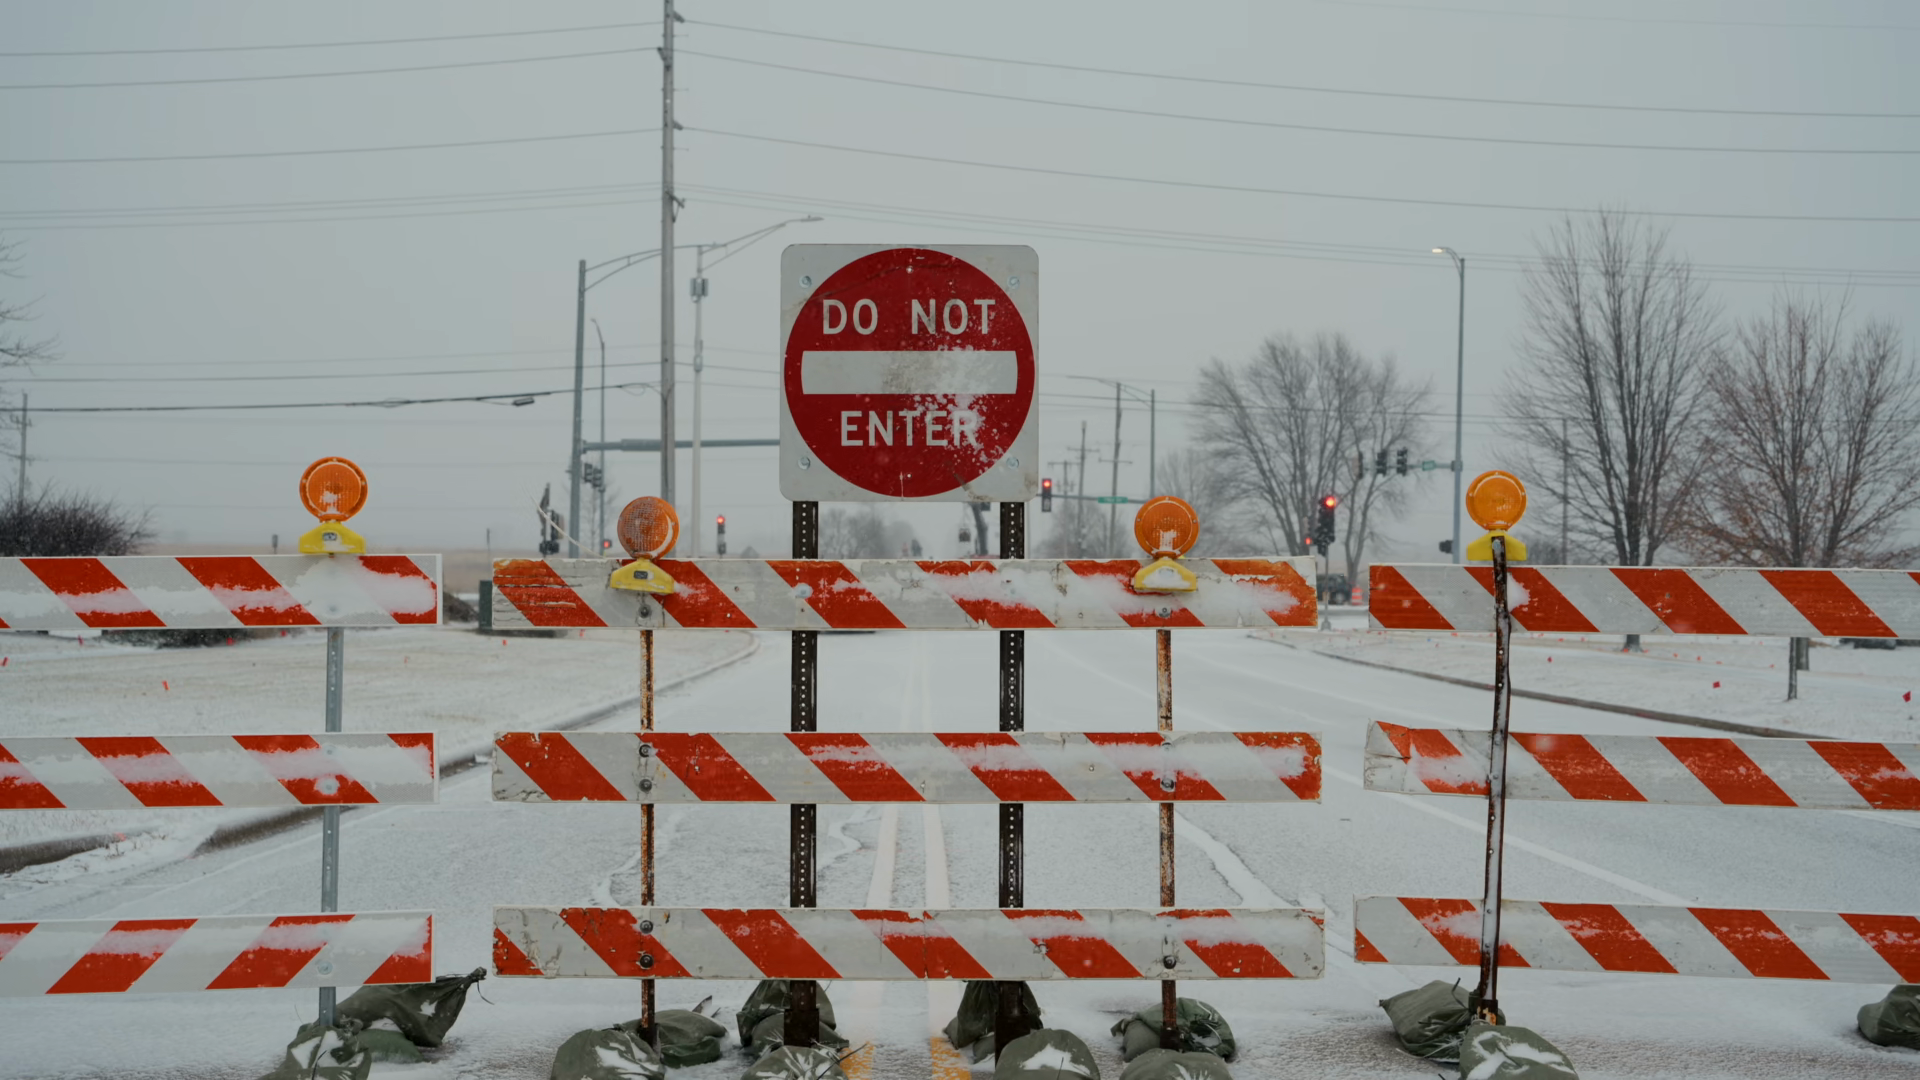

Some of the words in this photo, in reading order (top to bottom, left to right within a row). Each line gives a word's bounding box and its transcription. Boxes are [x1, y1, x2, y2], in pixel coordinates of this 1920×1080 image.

[822, 298, 878, 335] DO
[911, 298, 996, 335] NOT
[841, 410, 978, 447] ENTER
